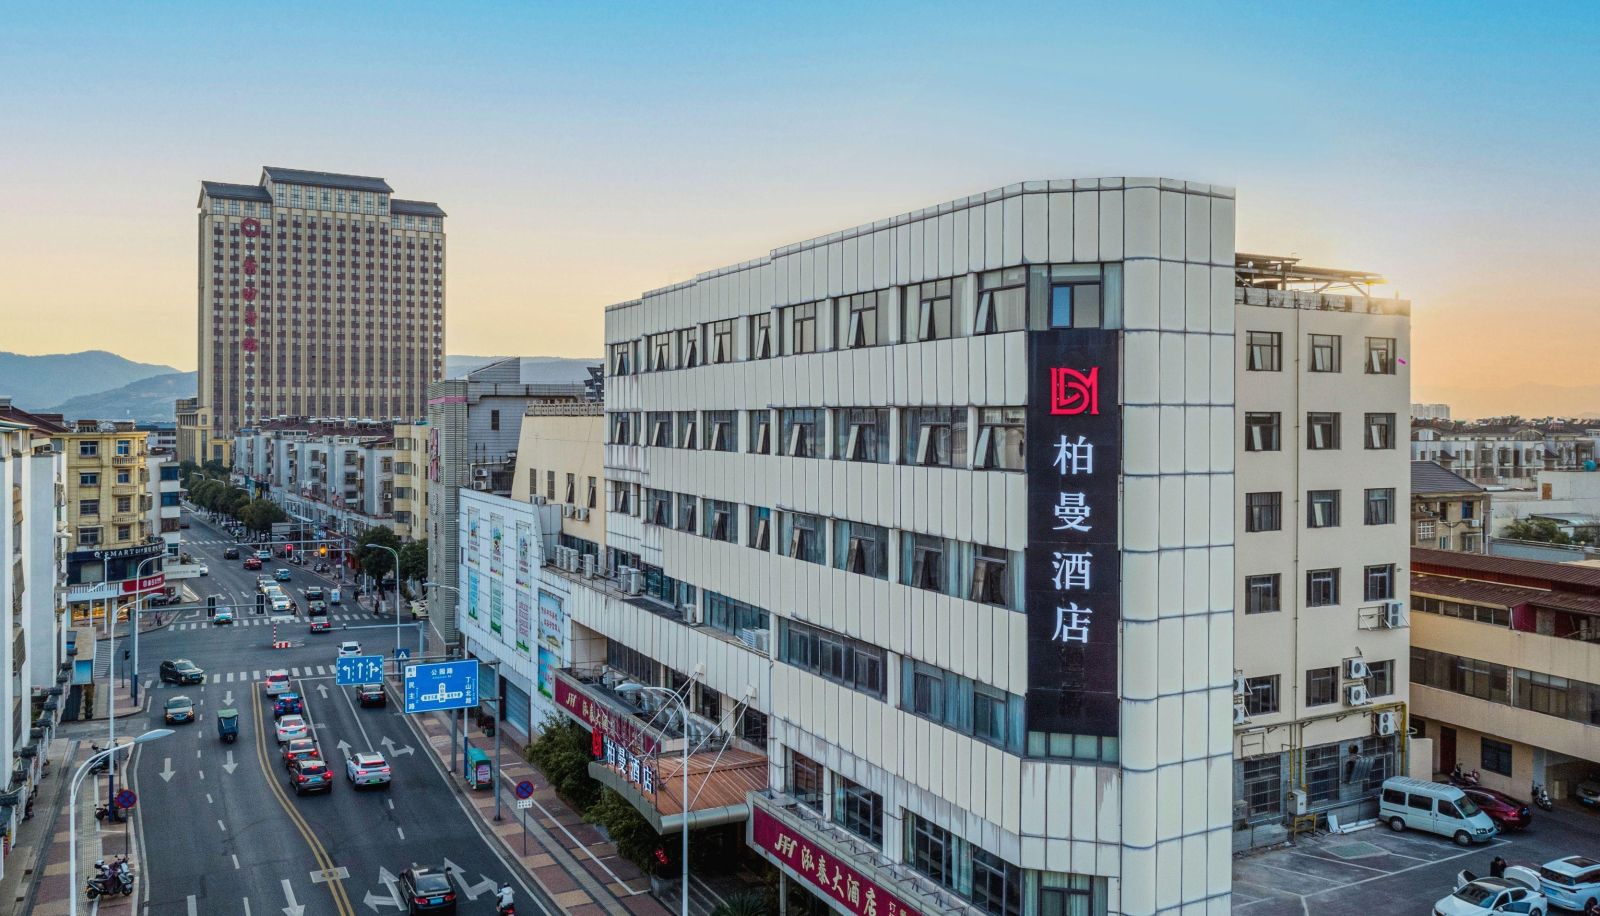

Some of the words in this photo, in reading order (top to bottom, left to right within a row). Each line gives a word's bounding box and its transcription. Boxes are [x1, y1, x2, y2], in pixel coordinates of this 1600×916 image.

[1051, 434, 1094, 644] 柏曼酒店
[431, 667, 453, 676] 公园路
[606, 739, 652, 794] 柏曼酒店
